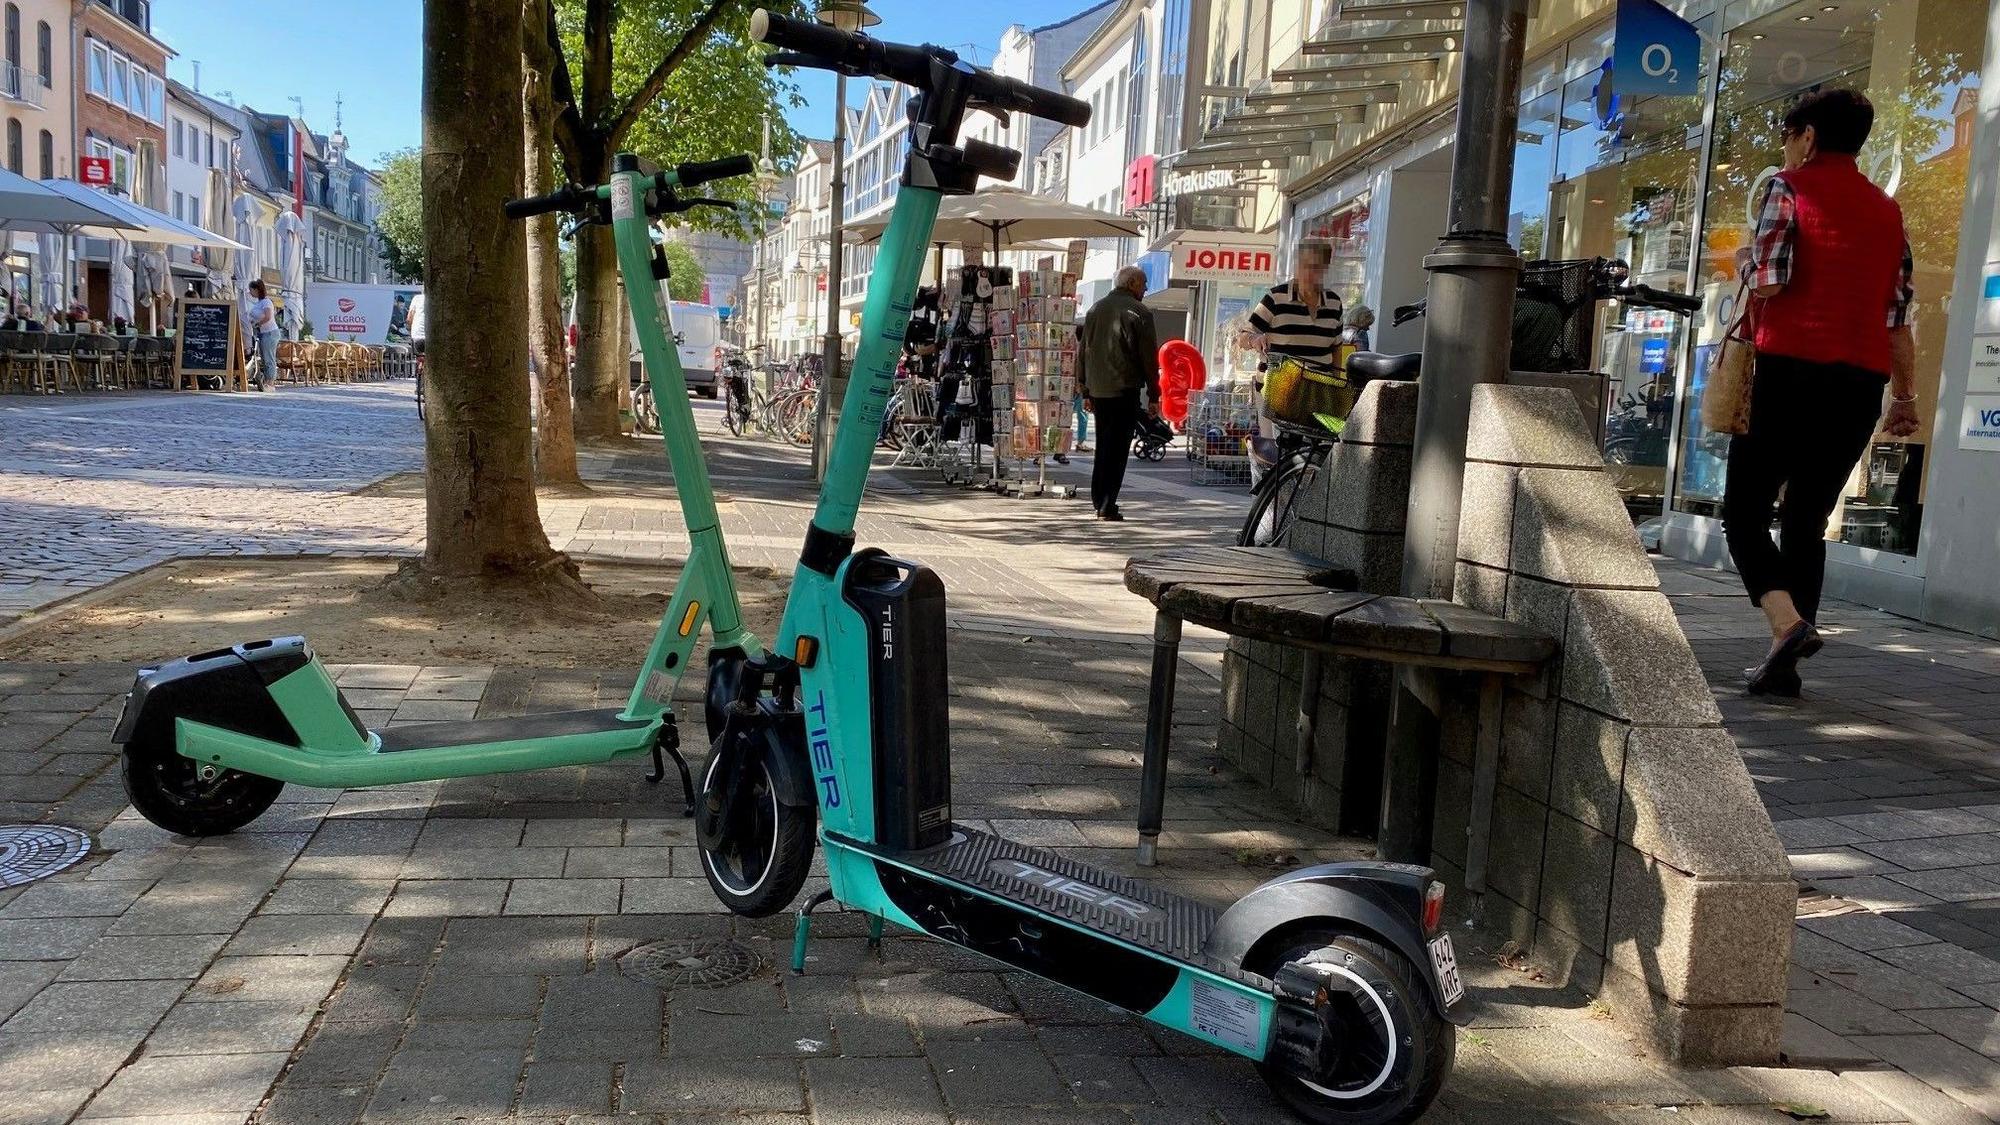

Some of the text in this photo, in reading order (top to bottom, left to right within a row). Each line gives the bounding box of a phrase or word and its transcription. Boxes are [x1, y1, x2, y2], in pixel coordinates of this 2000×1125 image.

[1161, 166, 1234, 198] Hörakustik
[1185, 250, 1271, 271] JONEN
[328, 314, 366, 324] SELGROS
[882, 604, 894, 661] TIER
[808, 689, 841, 810] TIER
[1012, 861, 1151, 920] TIER
[1434, 937, 1453, 968] 642
